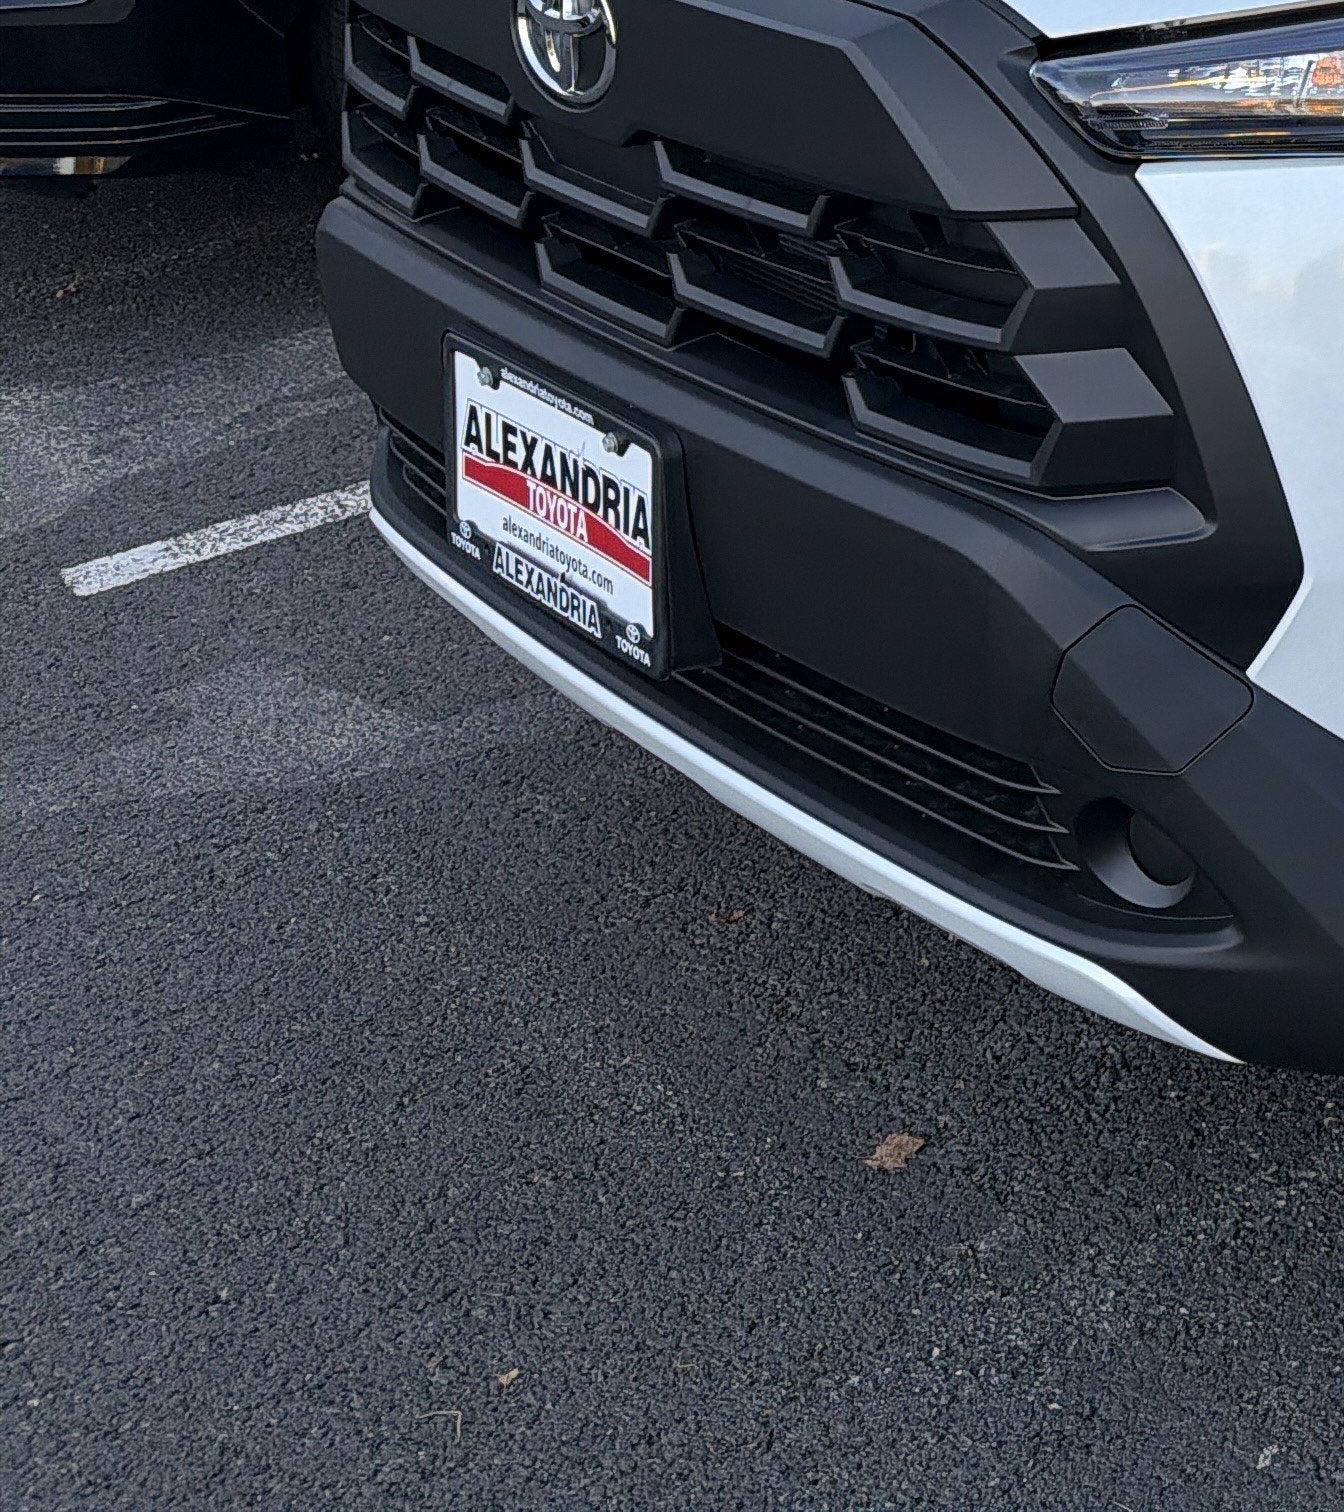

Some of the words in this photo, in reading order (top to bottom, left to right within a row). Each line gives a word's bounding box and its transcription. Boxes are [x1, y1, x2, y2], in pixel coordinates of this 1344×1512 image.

[463, 402, 651, 552] ALEXANDRIA
[526, 479, 590, 543] TOYOTA
[451, 532, 481, 561] TOYOTA
[502, 514, 615, 597] alexandriatoyota.com
[493, 542, 602, 638] ALEXANDRIA
[616, 634, 651, 667] TOYOTA
